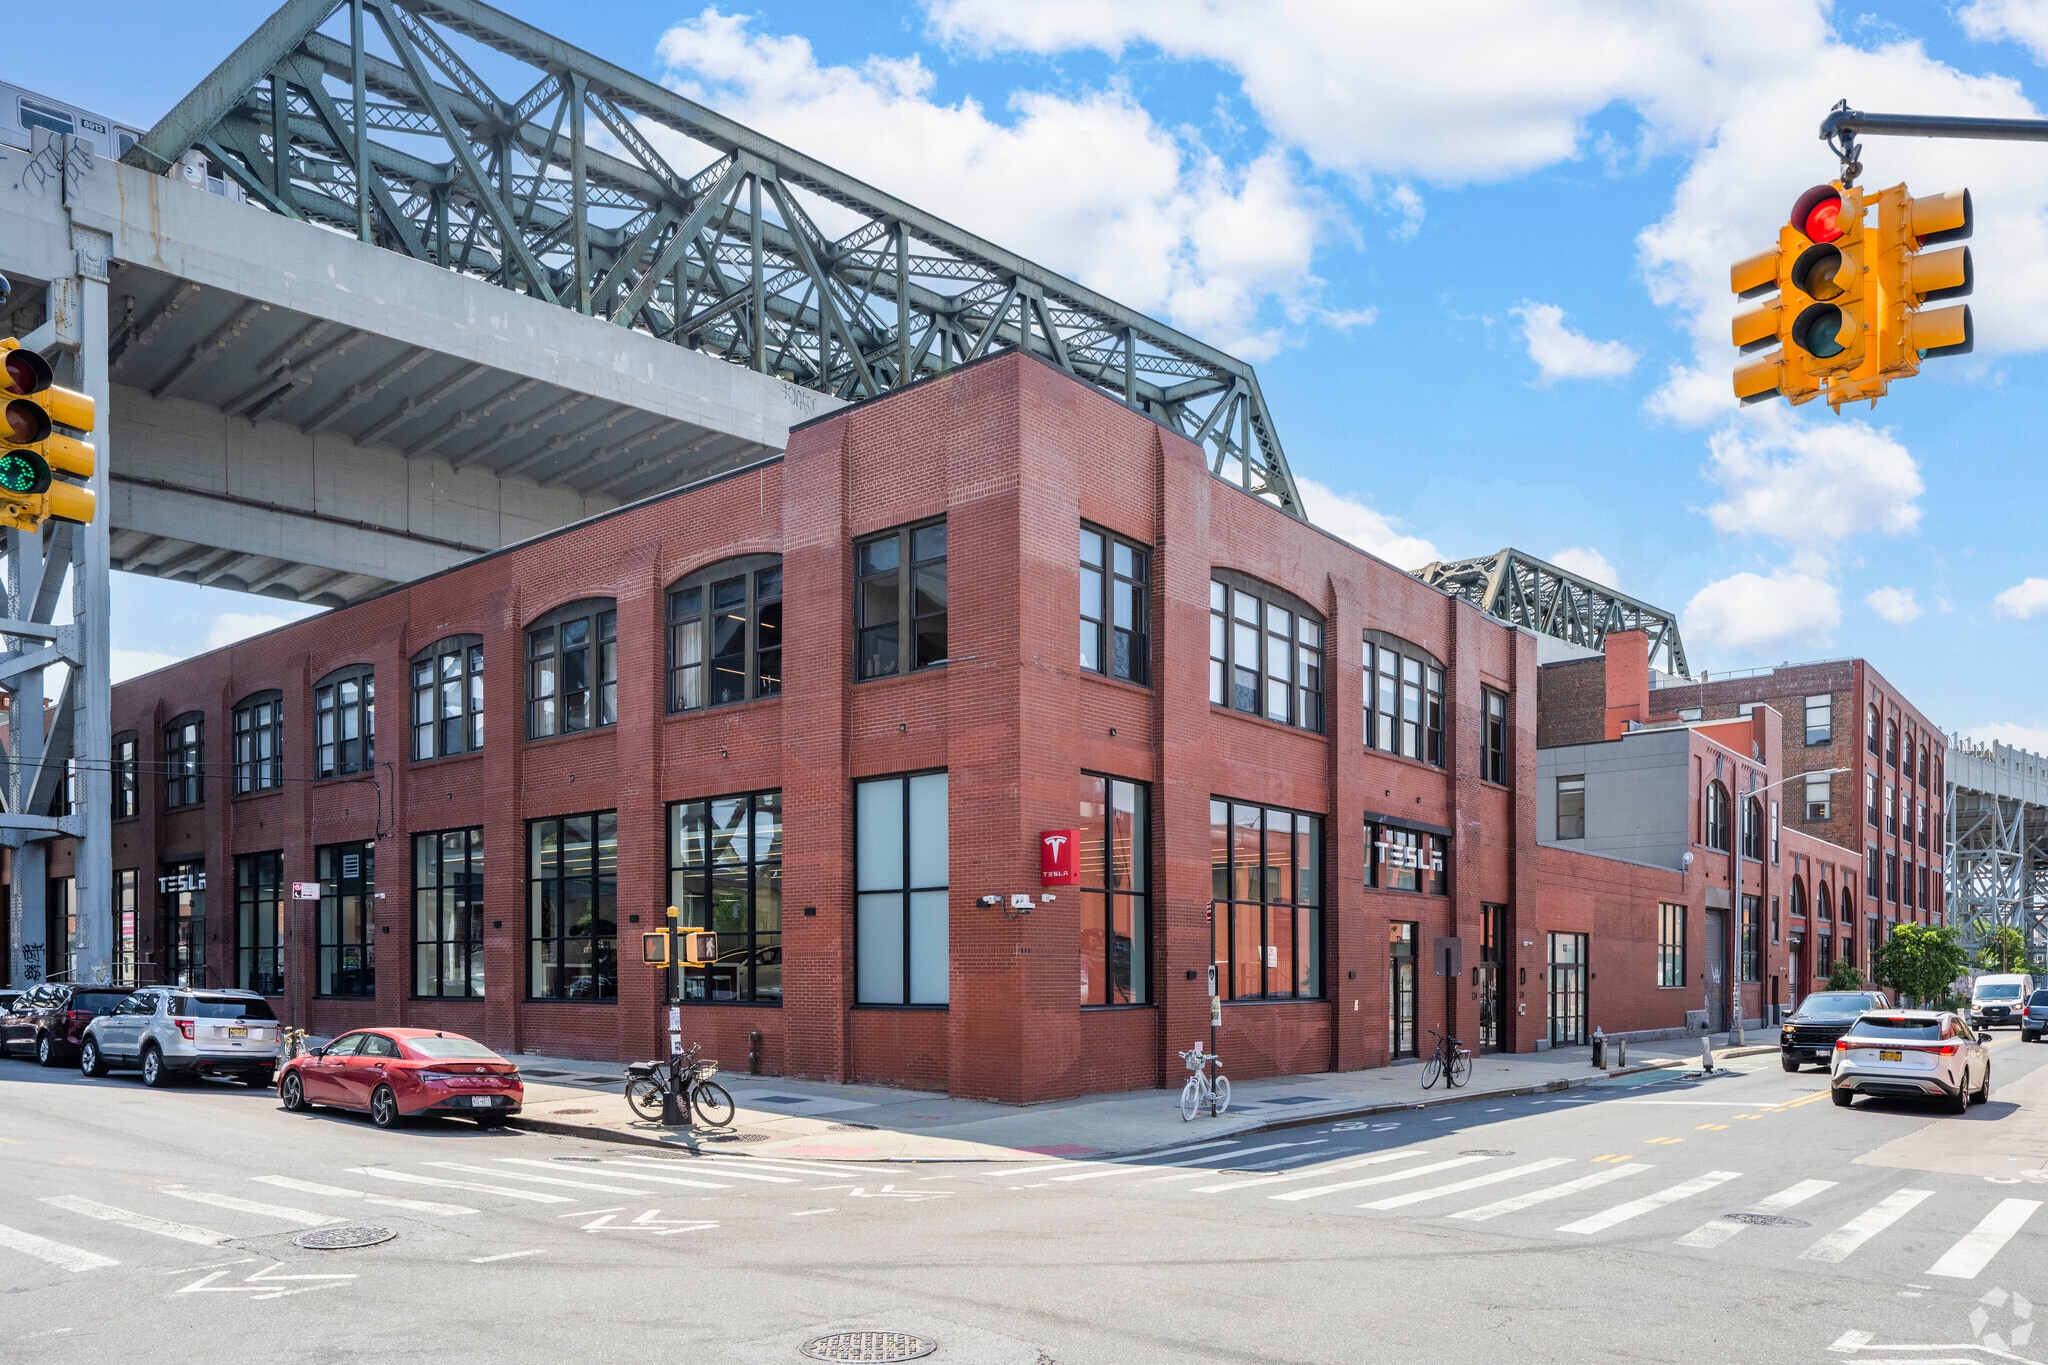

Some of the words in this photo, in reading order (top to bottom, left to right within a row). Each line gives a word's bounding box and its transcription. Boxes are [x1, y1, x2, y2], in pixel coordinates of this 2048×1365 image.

[83, 120, 104, 133] 8913
[1374, 841, 1443, 871] TESLA
[158, 873, 207, 893] TESLA
